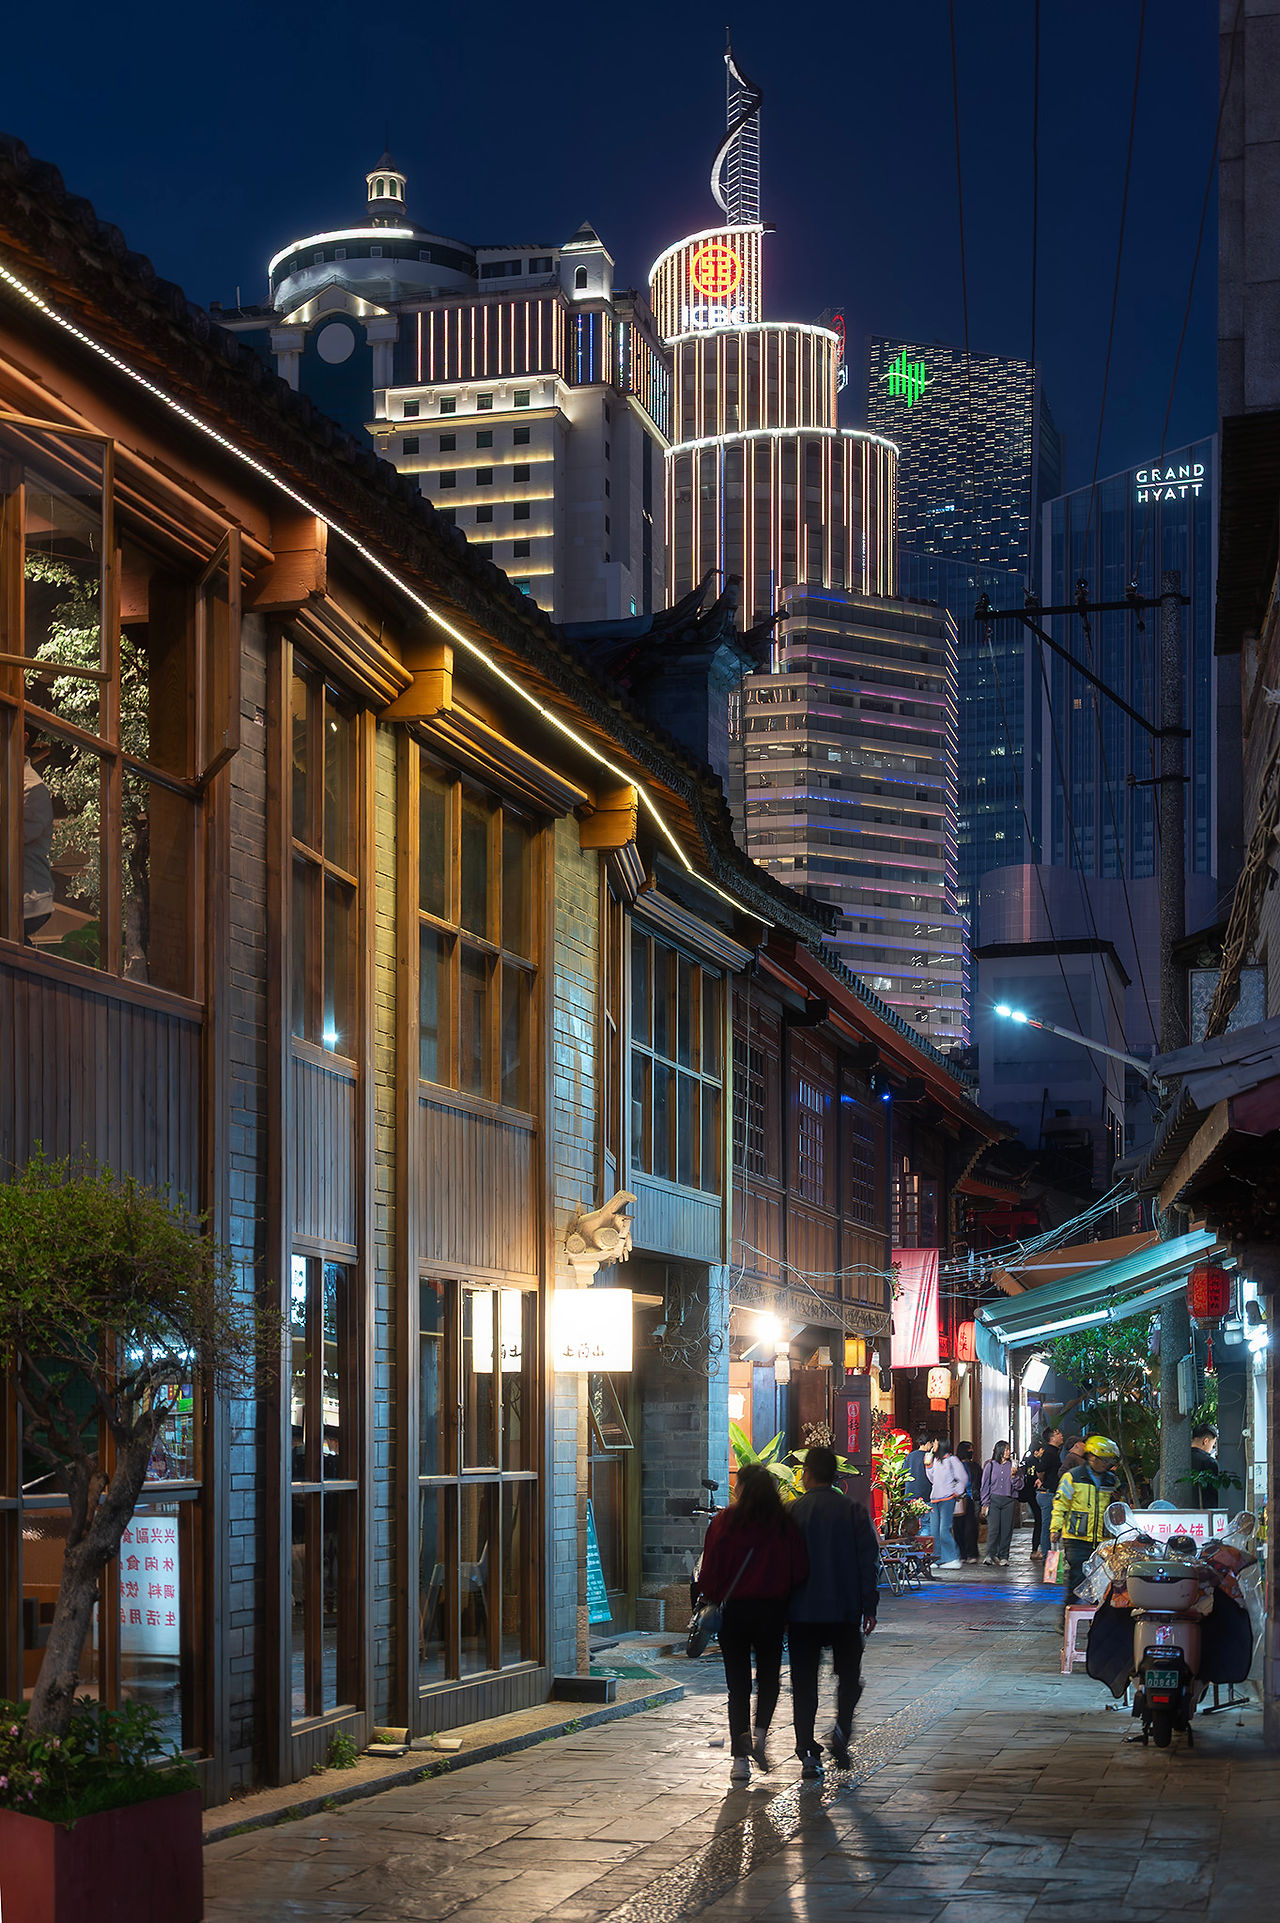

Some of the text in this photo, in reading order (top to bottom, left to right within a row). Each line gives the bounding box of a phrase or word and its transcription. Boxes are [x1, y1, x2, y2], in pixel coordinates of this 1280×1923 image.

[682, 305, 748, 327] ICBC
[1136, 464, 1204, 483] GRAND
[1137, 484, 1203, 503] HYATT
